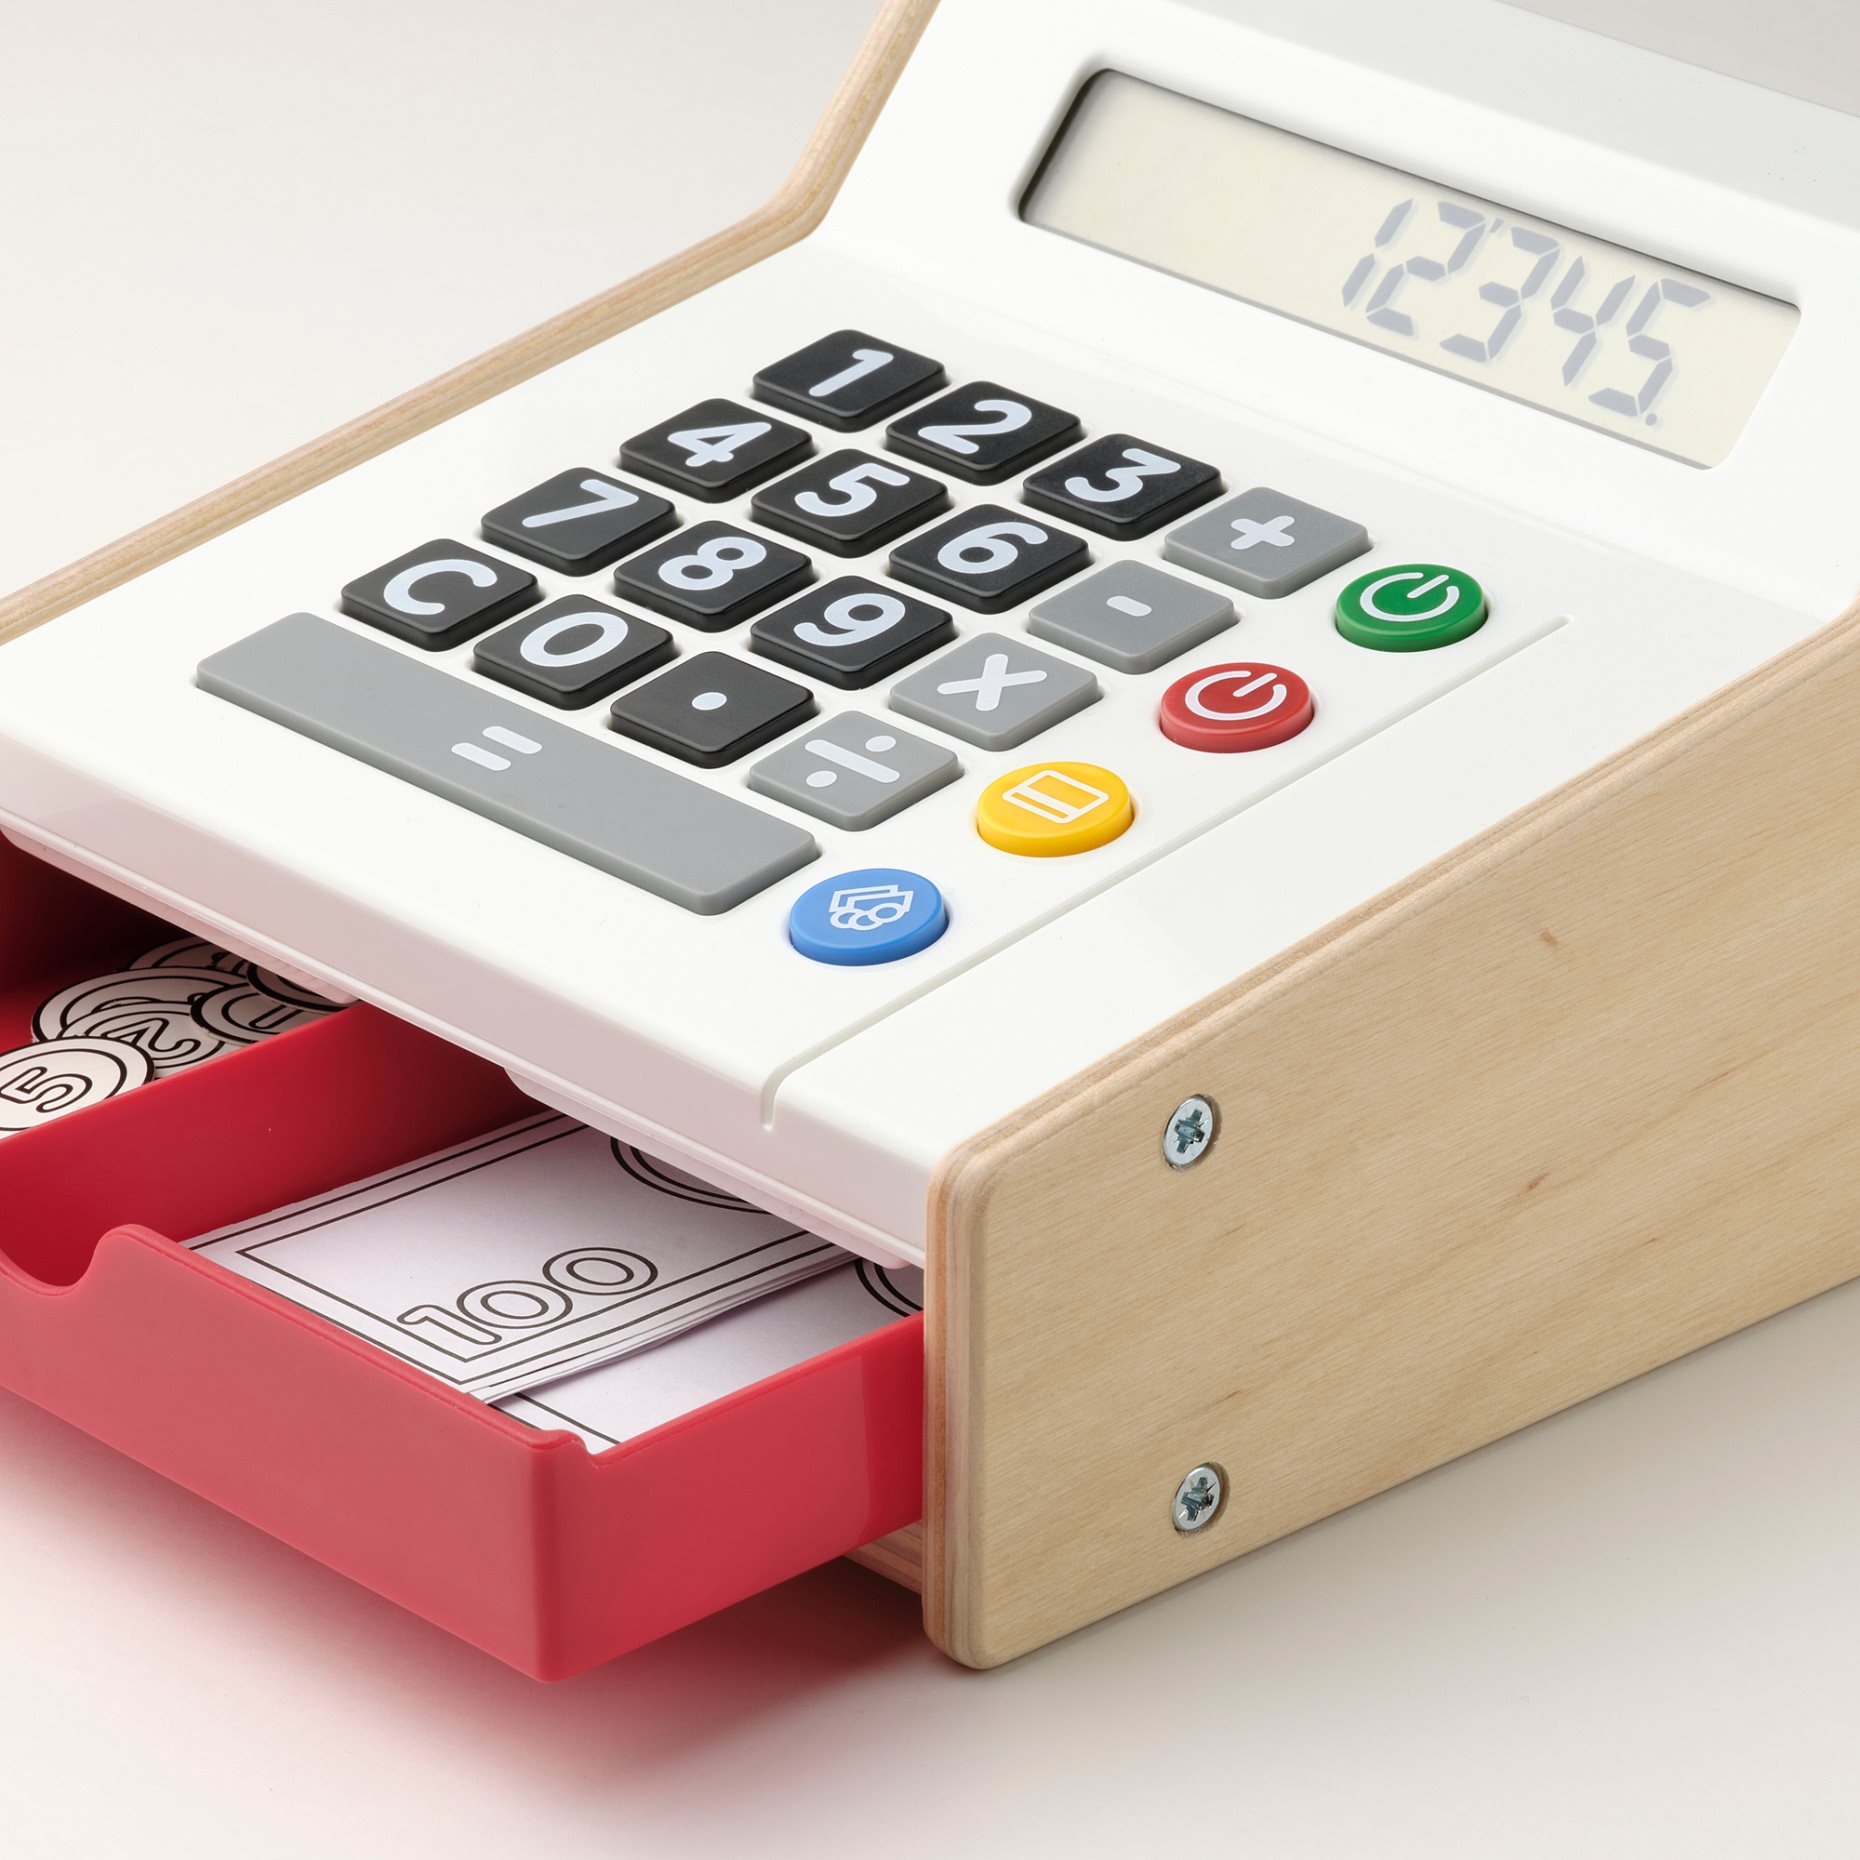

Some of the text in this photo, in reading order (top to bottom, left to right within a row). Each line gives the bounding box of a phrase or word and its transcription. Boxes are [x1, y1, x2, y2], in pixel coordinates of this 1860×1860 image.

[808, 348, 894, 397] 1
[667, 421, 772, 468] 4
[917, 399, 1033, 455] 2
[794, 462, 911, 518] 5
[1064, 447, 1182, 503] 3
[521, 478, 640, 529] 7
[657, 536, 767, 591] 8
[937, 521, 1049, 575] 6
[382, 558, 498, 616] C
[519, 611, 629, 668] 0
[793, 592, 906, 647] 9
[0, 1066, 93, 1113] 5
[396, 1246, 659, 1346] 100
